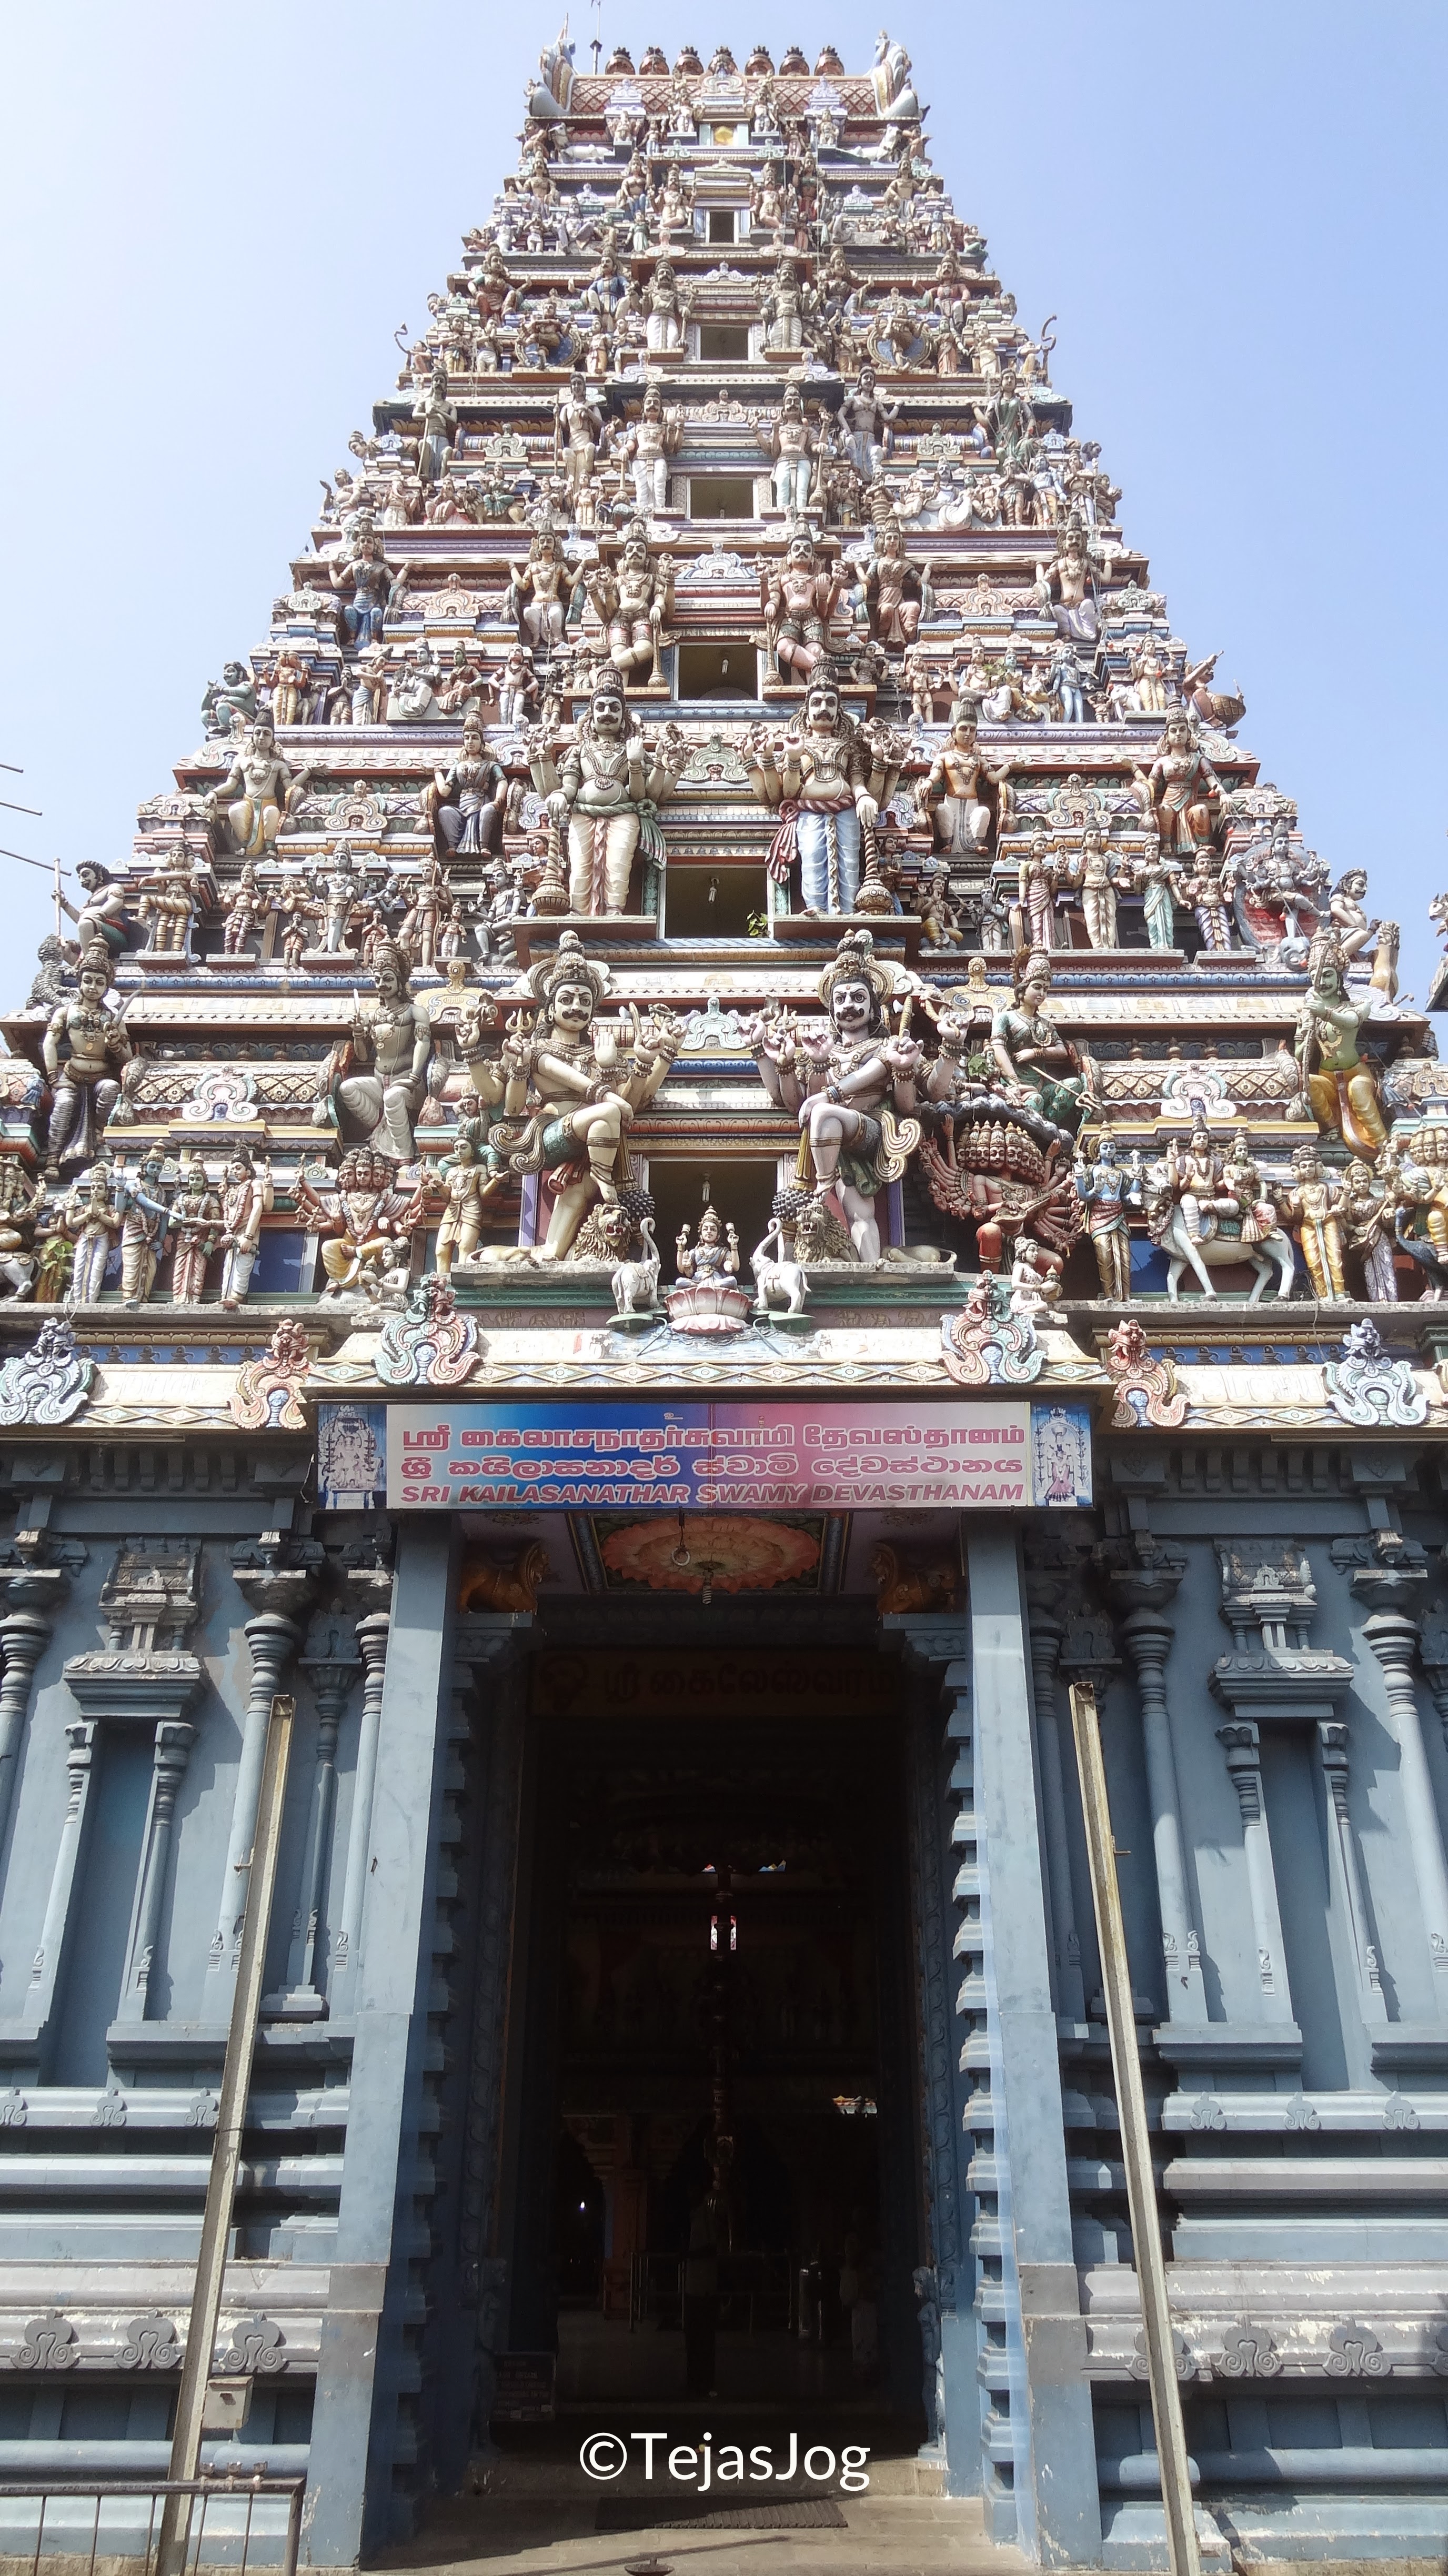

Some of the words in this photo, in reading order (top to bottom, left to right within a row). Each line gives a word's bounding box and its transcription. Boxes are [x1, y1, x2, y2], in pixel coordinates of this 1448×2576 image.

[805, 1424, 1024, 1450] தேவஸ்தானம்
[400, 1485, 451, 1502] SRI
[459, 1485, 689, 1502] KAILASANATHAR
[697, 1484, 806, 1502] SWAMY
[812, 1484, 1024, 1501] DEVASTHANAM
